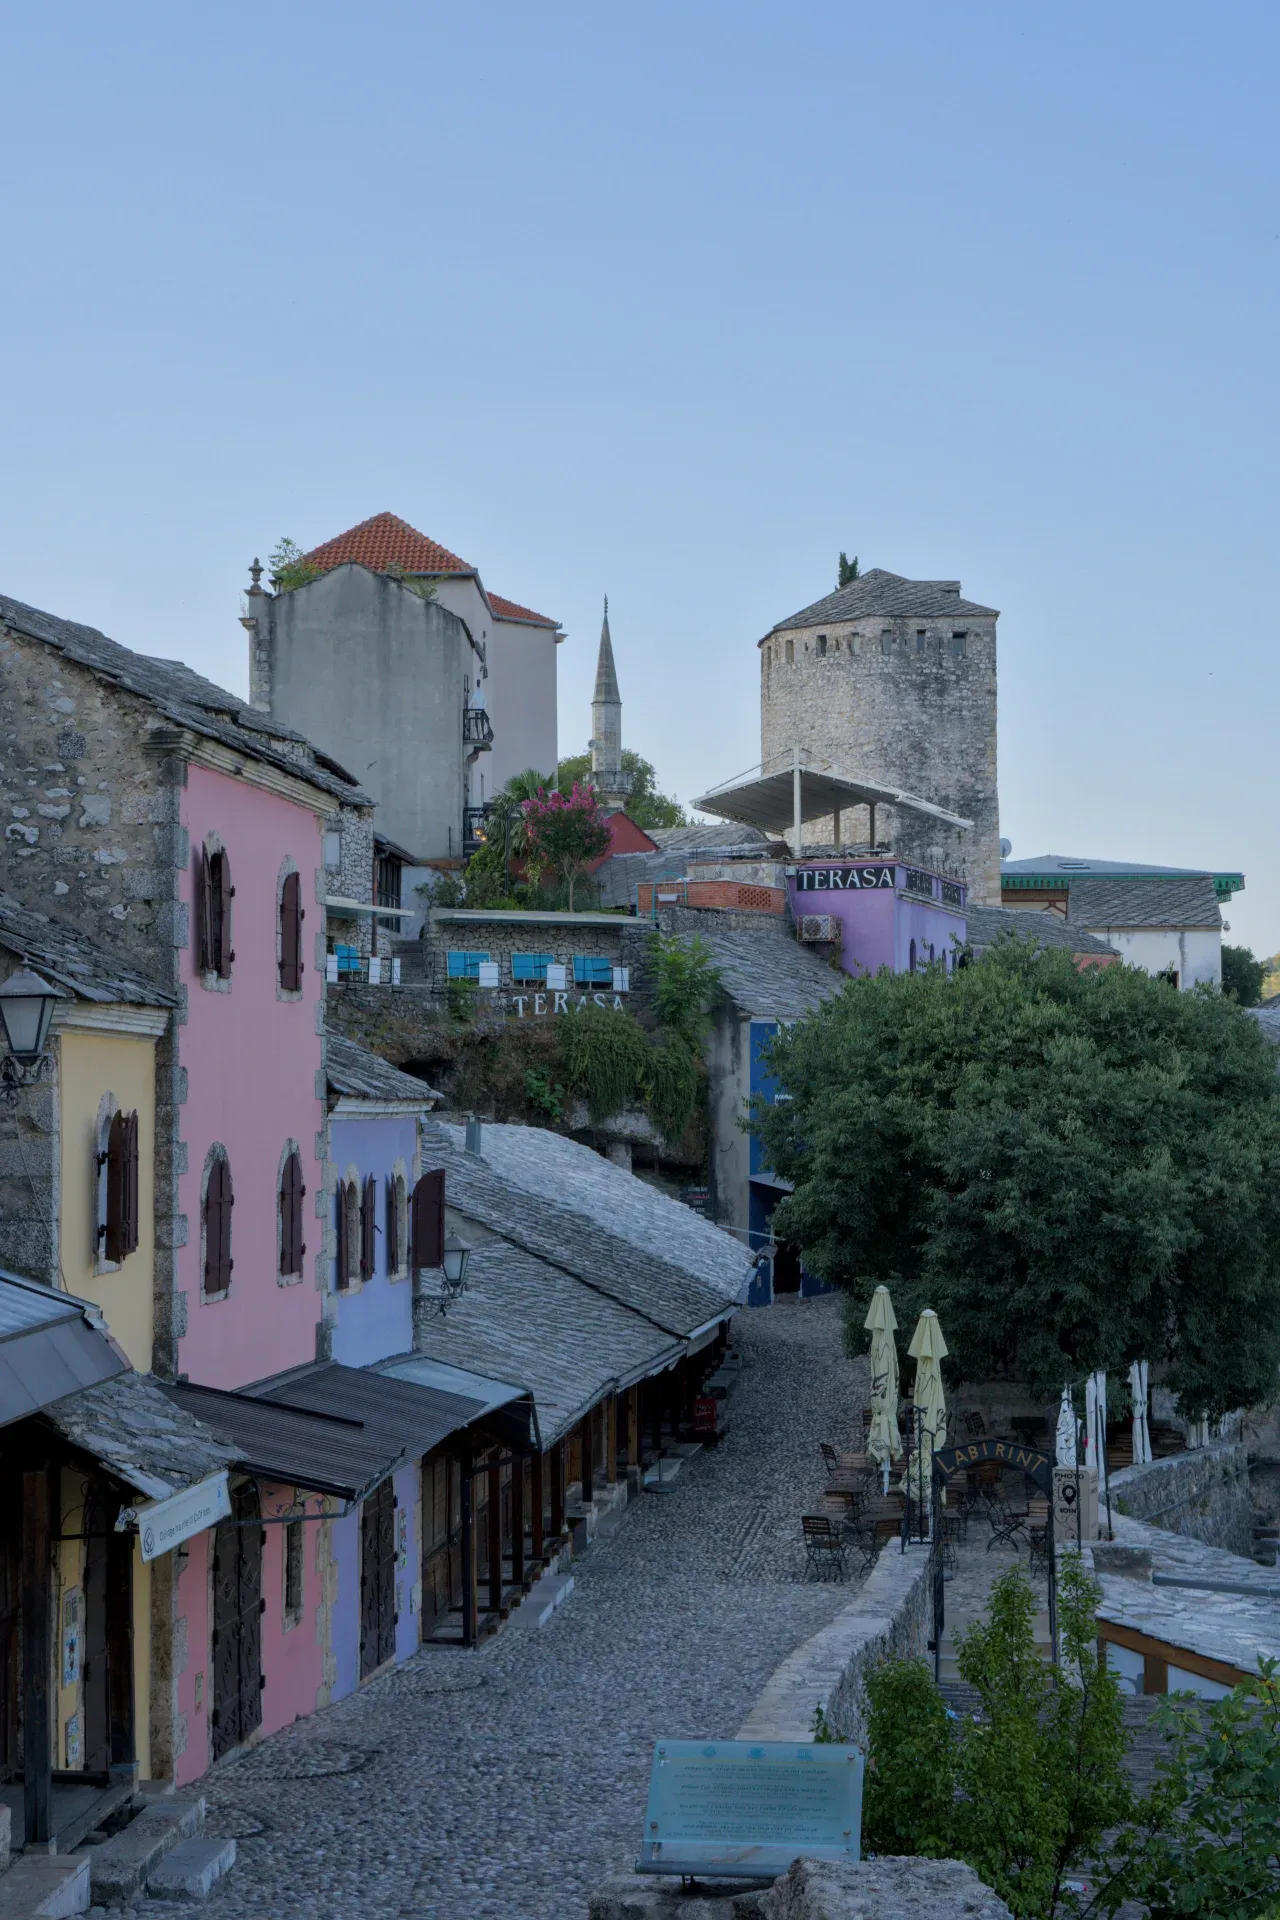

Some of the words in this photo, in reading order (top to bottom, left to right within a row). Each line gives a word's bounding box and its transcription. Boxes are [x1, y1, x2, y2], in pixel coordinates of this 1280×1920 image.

[800, 868, 894, 889] TERASA
[513, 992, 626, 1018] TERASA
[935, 1443, 1049, 1474] LABIRINT
